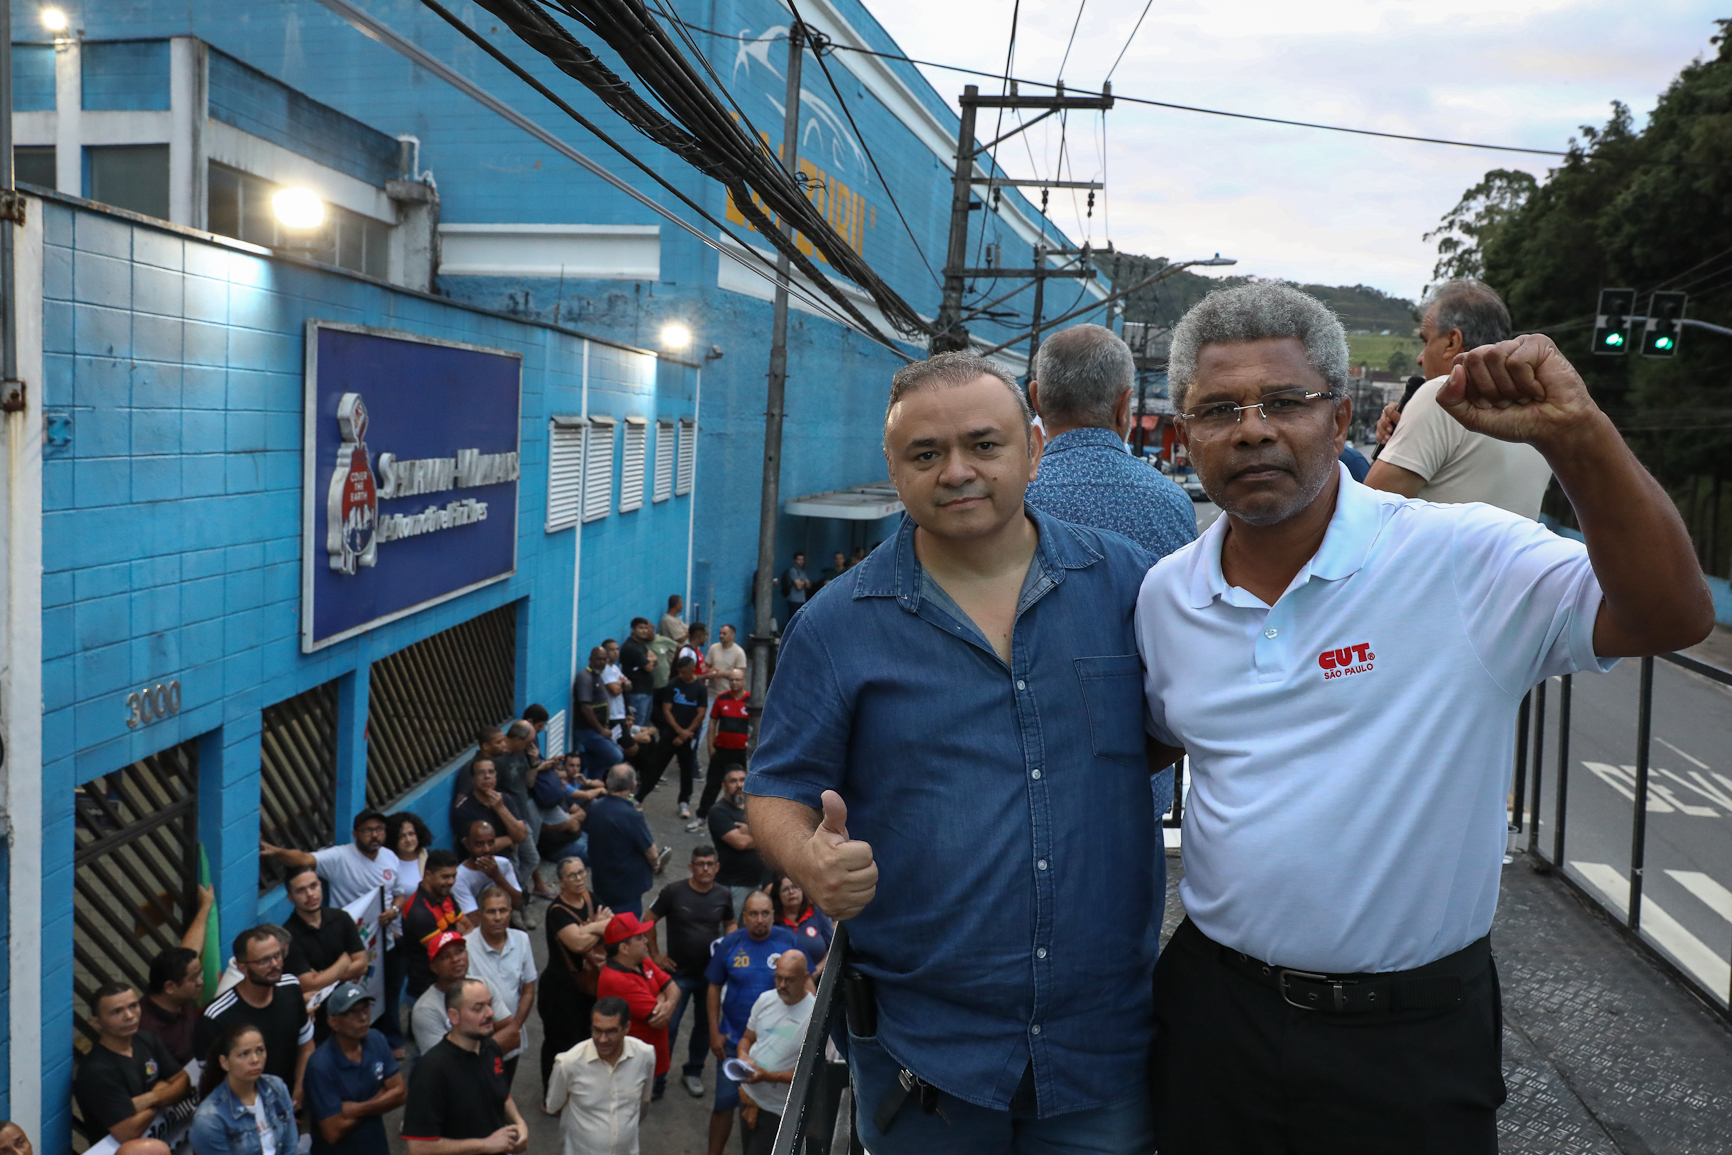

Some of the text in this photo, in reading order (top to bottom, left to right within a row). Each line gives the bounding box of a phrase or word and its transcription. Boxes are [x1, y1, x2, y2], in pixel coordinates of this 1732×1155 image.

[354, 482, 364, 491] THE
[350, 491, 368, 502] EARTH
[1318, 642, 1370, 670] CUT
[1324, 663, 1374, 680] SÃO PAULO
[126, 680, 182, 728] 3000
[733, 955, 750, 968] 20
